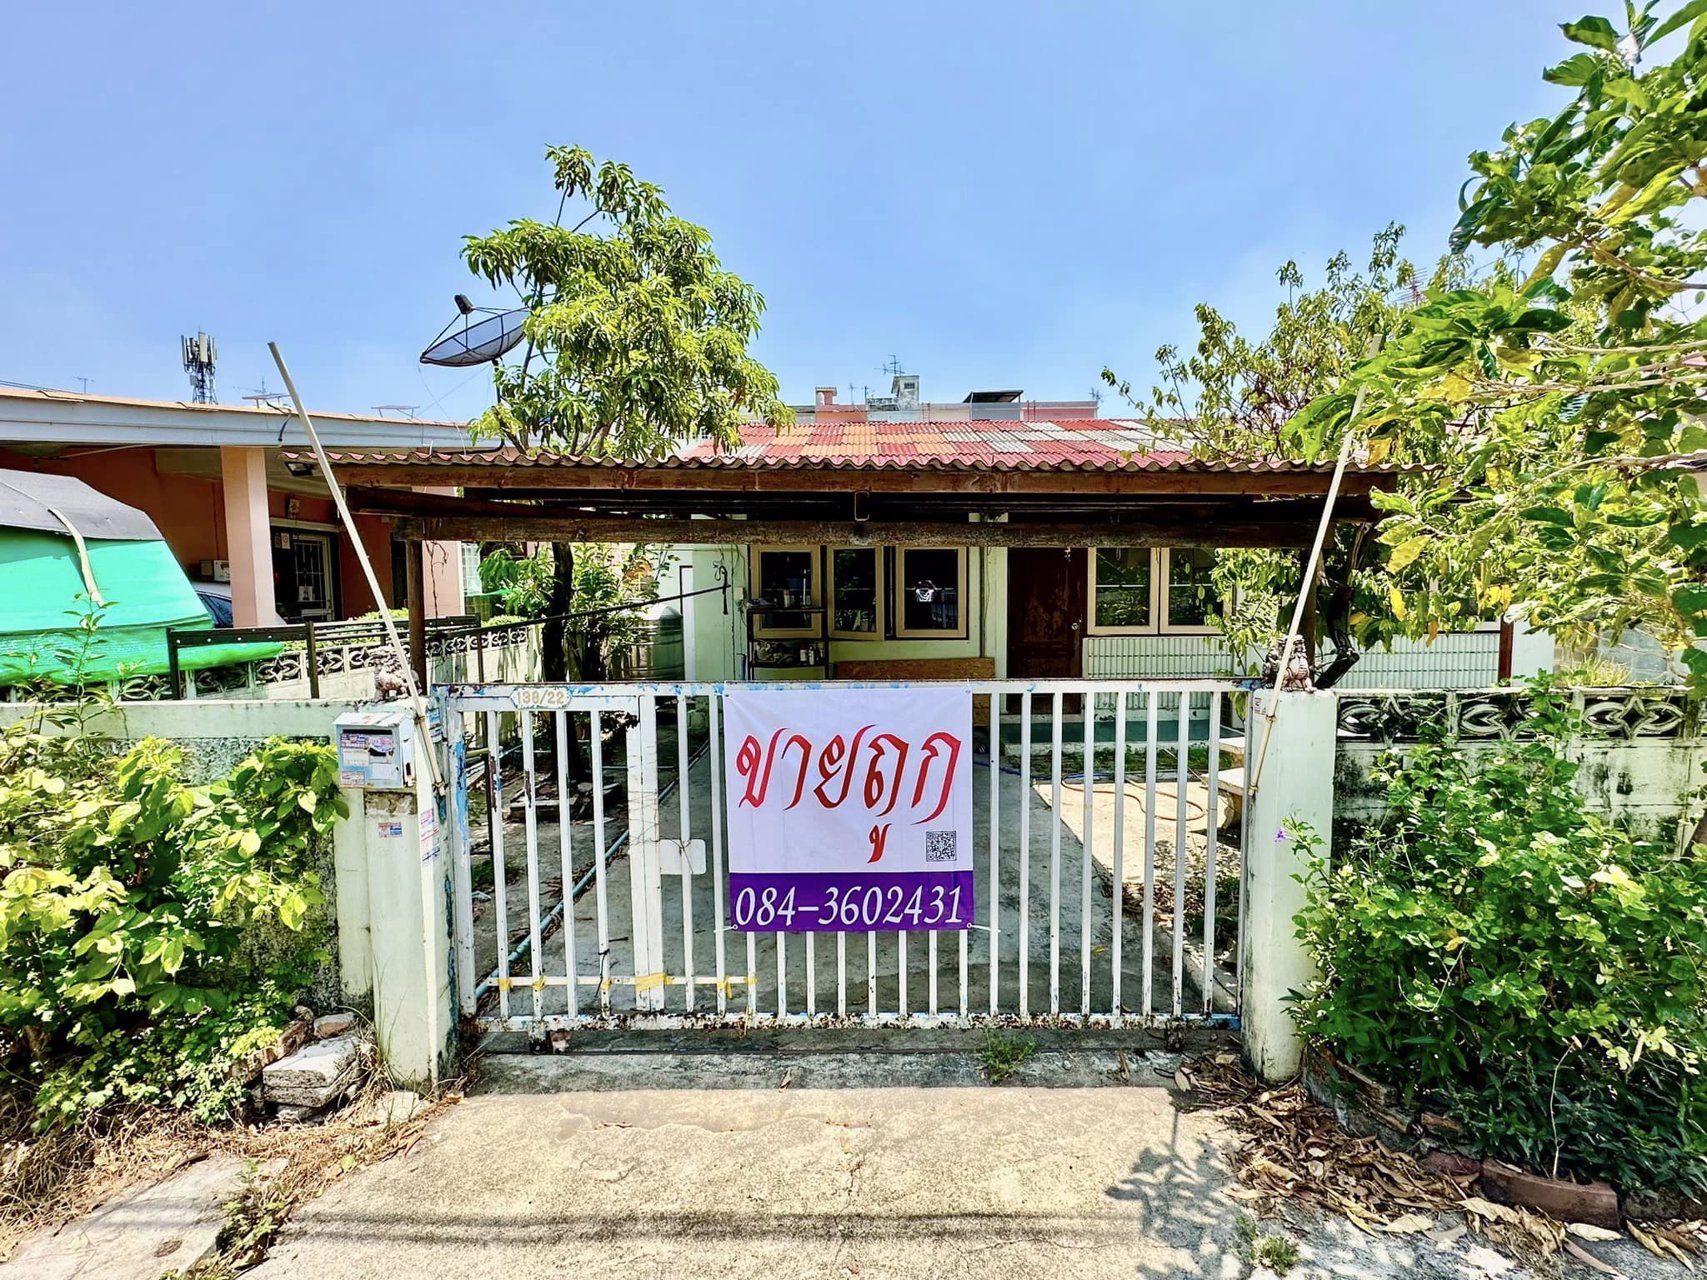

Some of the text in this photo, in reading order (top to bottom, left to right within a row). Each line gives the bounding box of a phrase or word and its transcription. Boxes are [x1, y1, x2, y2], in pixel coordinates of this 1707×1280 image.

[736, 724, 962, 864] ขายถูก
[735, 885, 963, 926] 084-3602431
